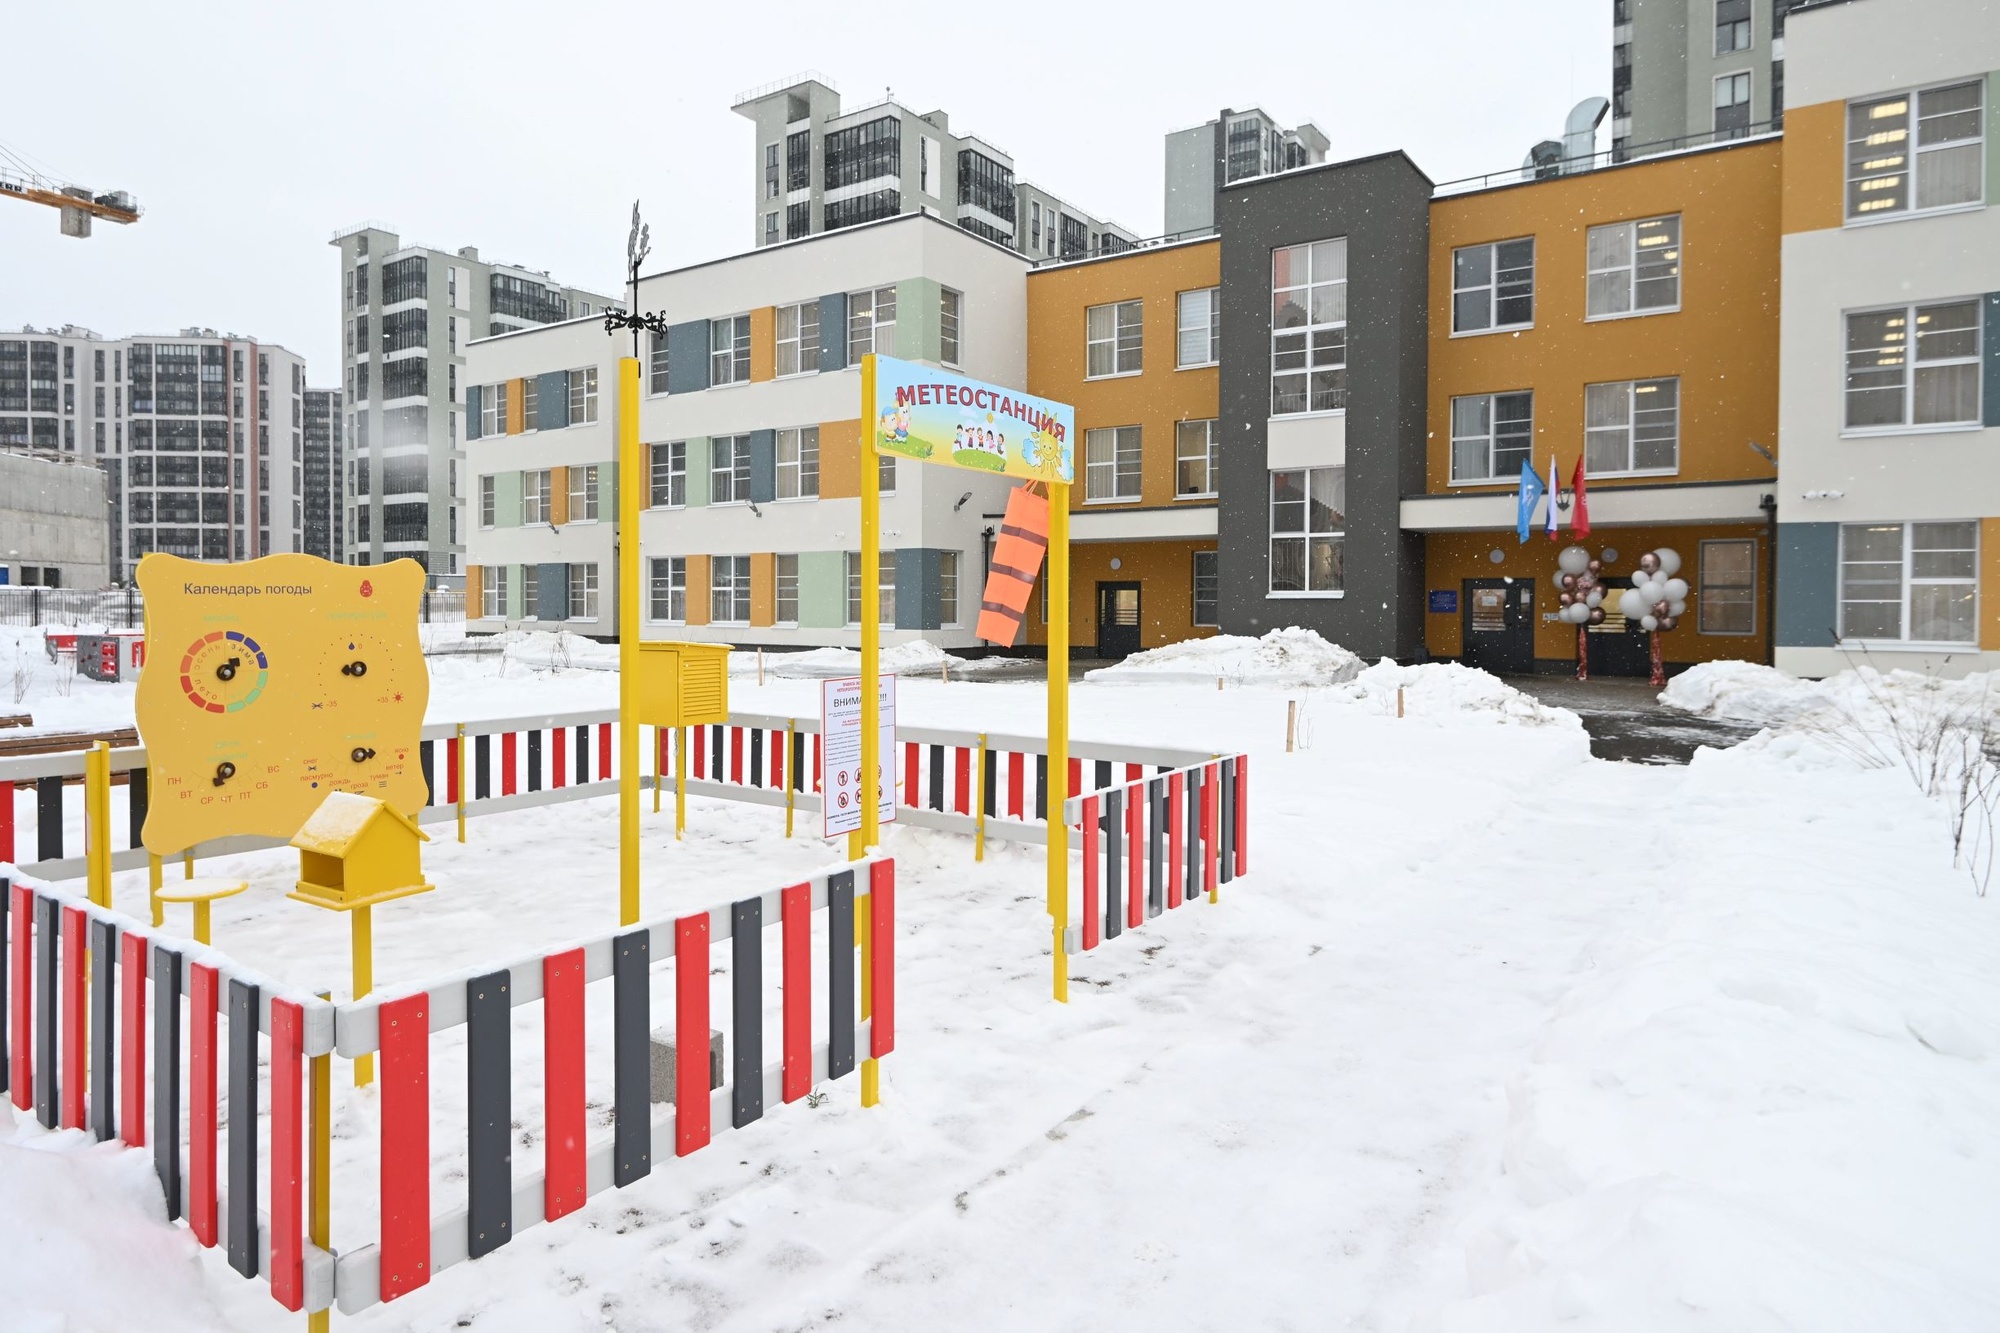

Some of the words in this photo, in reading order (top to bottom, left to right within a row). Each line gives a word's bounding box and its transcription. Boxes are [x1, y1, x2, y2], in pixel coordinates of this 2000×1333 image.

[896, 384, 1066, 443] МЕТЕОСТАНЦИЯ
[184, 583, 261, 596] Календарь
[265, 585, 312, 596] погоды
[231, 644, 255, 665] зима
[194, 679, 218, 700] лето
[377, 695, 389, 703] +35
[326, 700, 338, 708] -35
[267, 765, 280, 774] ВС
[385, 763, 404, 771] ветер
[167, 777, 182, 786] ПН
[300, 772, 334, 782] пасмурно
[369, 773, 389, 781] туман
[255, 782, 268, 790] СБ
[328, 778, 351, 787] дождь
[350, 782, 369, 790] гроза
[180, 790, 193, 799] ВТ
[220, 795, 233, 803] ЧТ
[239, 791, 252, 800] ПТ
[200, 796, 214, 805] СР
